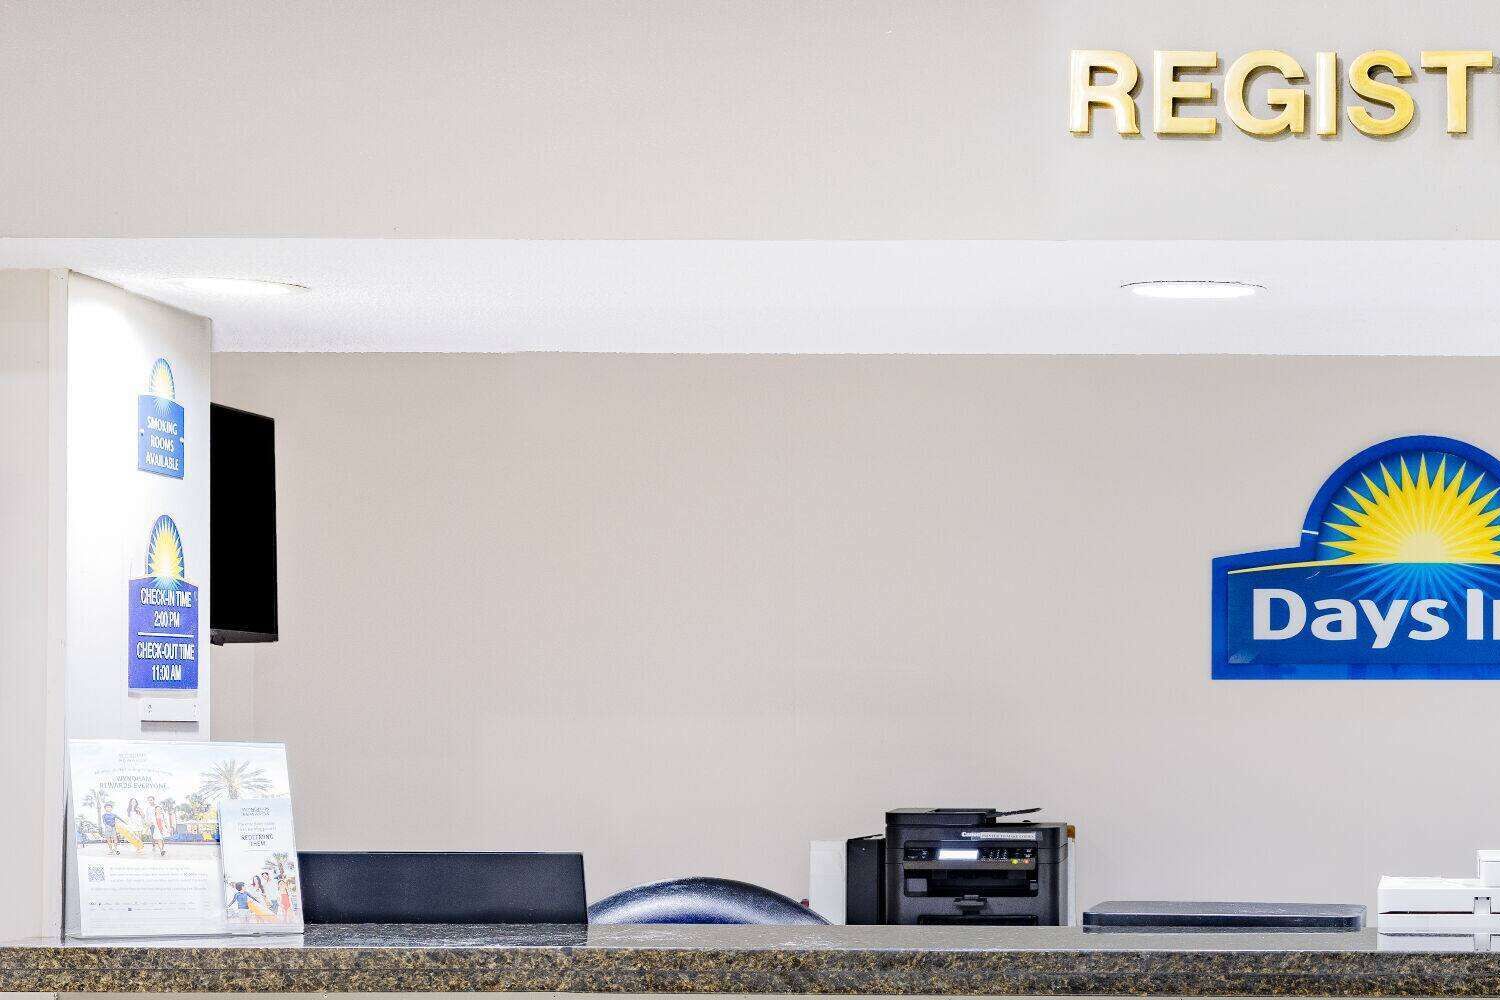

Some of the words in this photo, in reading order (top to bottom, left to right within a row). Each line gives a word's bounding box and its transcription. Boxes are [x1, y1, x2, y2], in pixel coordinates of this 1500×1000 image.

[146, 416, 178, 435] SMOKING
[150, 434, 175, 453] ROOMS
[145, 451, 179, 471] AVAILABLE
[140, 588, 175, 606] CHECK-IN
[176, 590, 192, 607] TIME
[169, 611, 180, 628] PM
[1252, 588, 1451, 650] Days
[136, 642, 178, 660] CHECK-OUT
[179, 643, 195, 660] TIME
[152, 664, 170, 680] 11:00
[171, 664, 182, 681] AM
